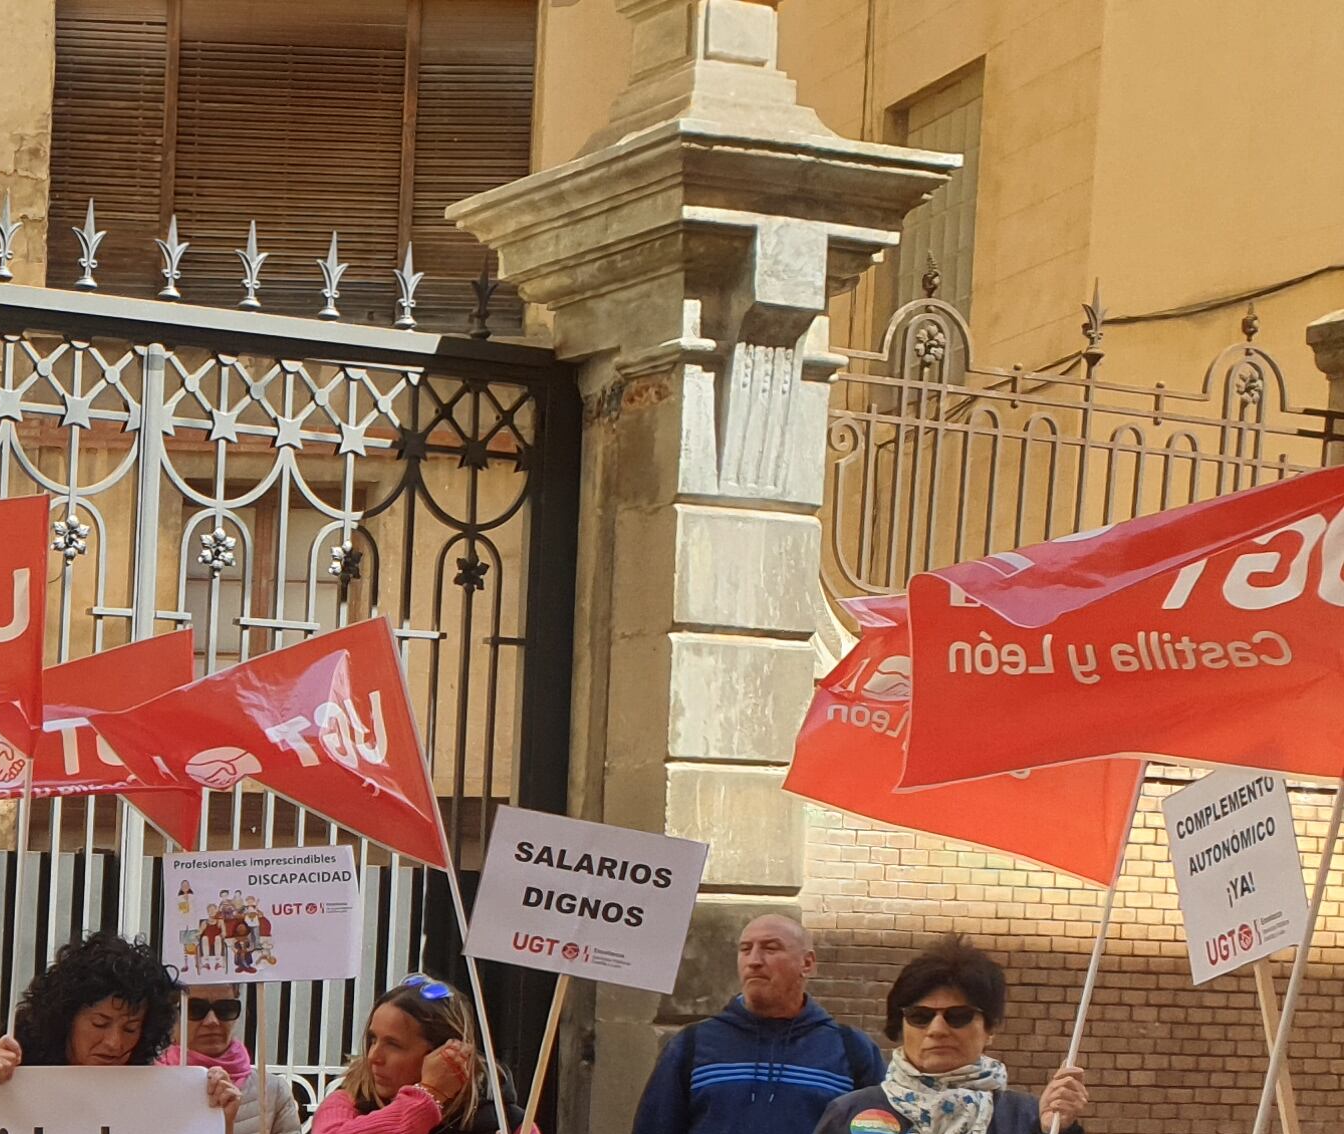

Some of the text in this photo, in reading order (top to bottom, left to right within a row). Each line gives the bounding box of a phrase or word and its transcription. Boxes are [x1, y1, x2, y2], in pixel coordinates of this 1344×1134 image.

[1176, 775, 1275, 840] COMPLEMENTO
[173, 854, 337, 869] Profesionales imprescindibles
[248, 870, 352, 886] DISCAPACIDAD
[514, 841, 673, 888] SALARIOS
[522, 886, 644, 927] DIGNOS
[1227, 871, 1256, 908] ¡YA!
[272, 903, 303, 916] UGT
[512, 931, 560, 956] UGT
[1206, 927, 1238, 966] UGT
